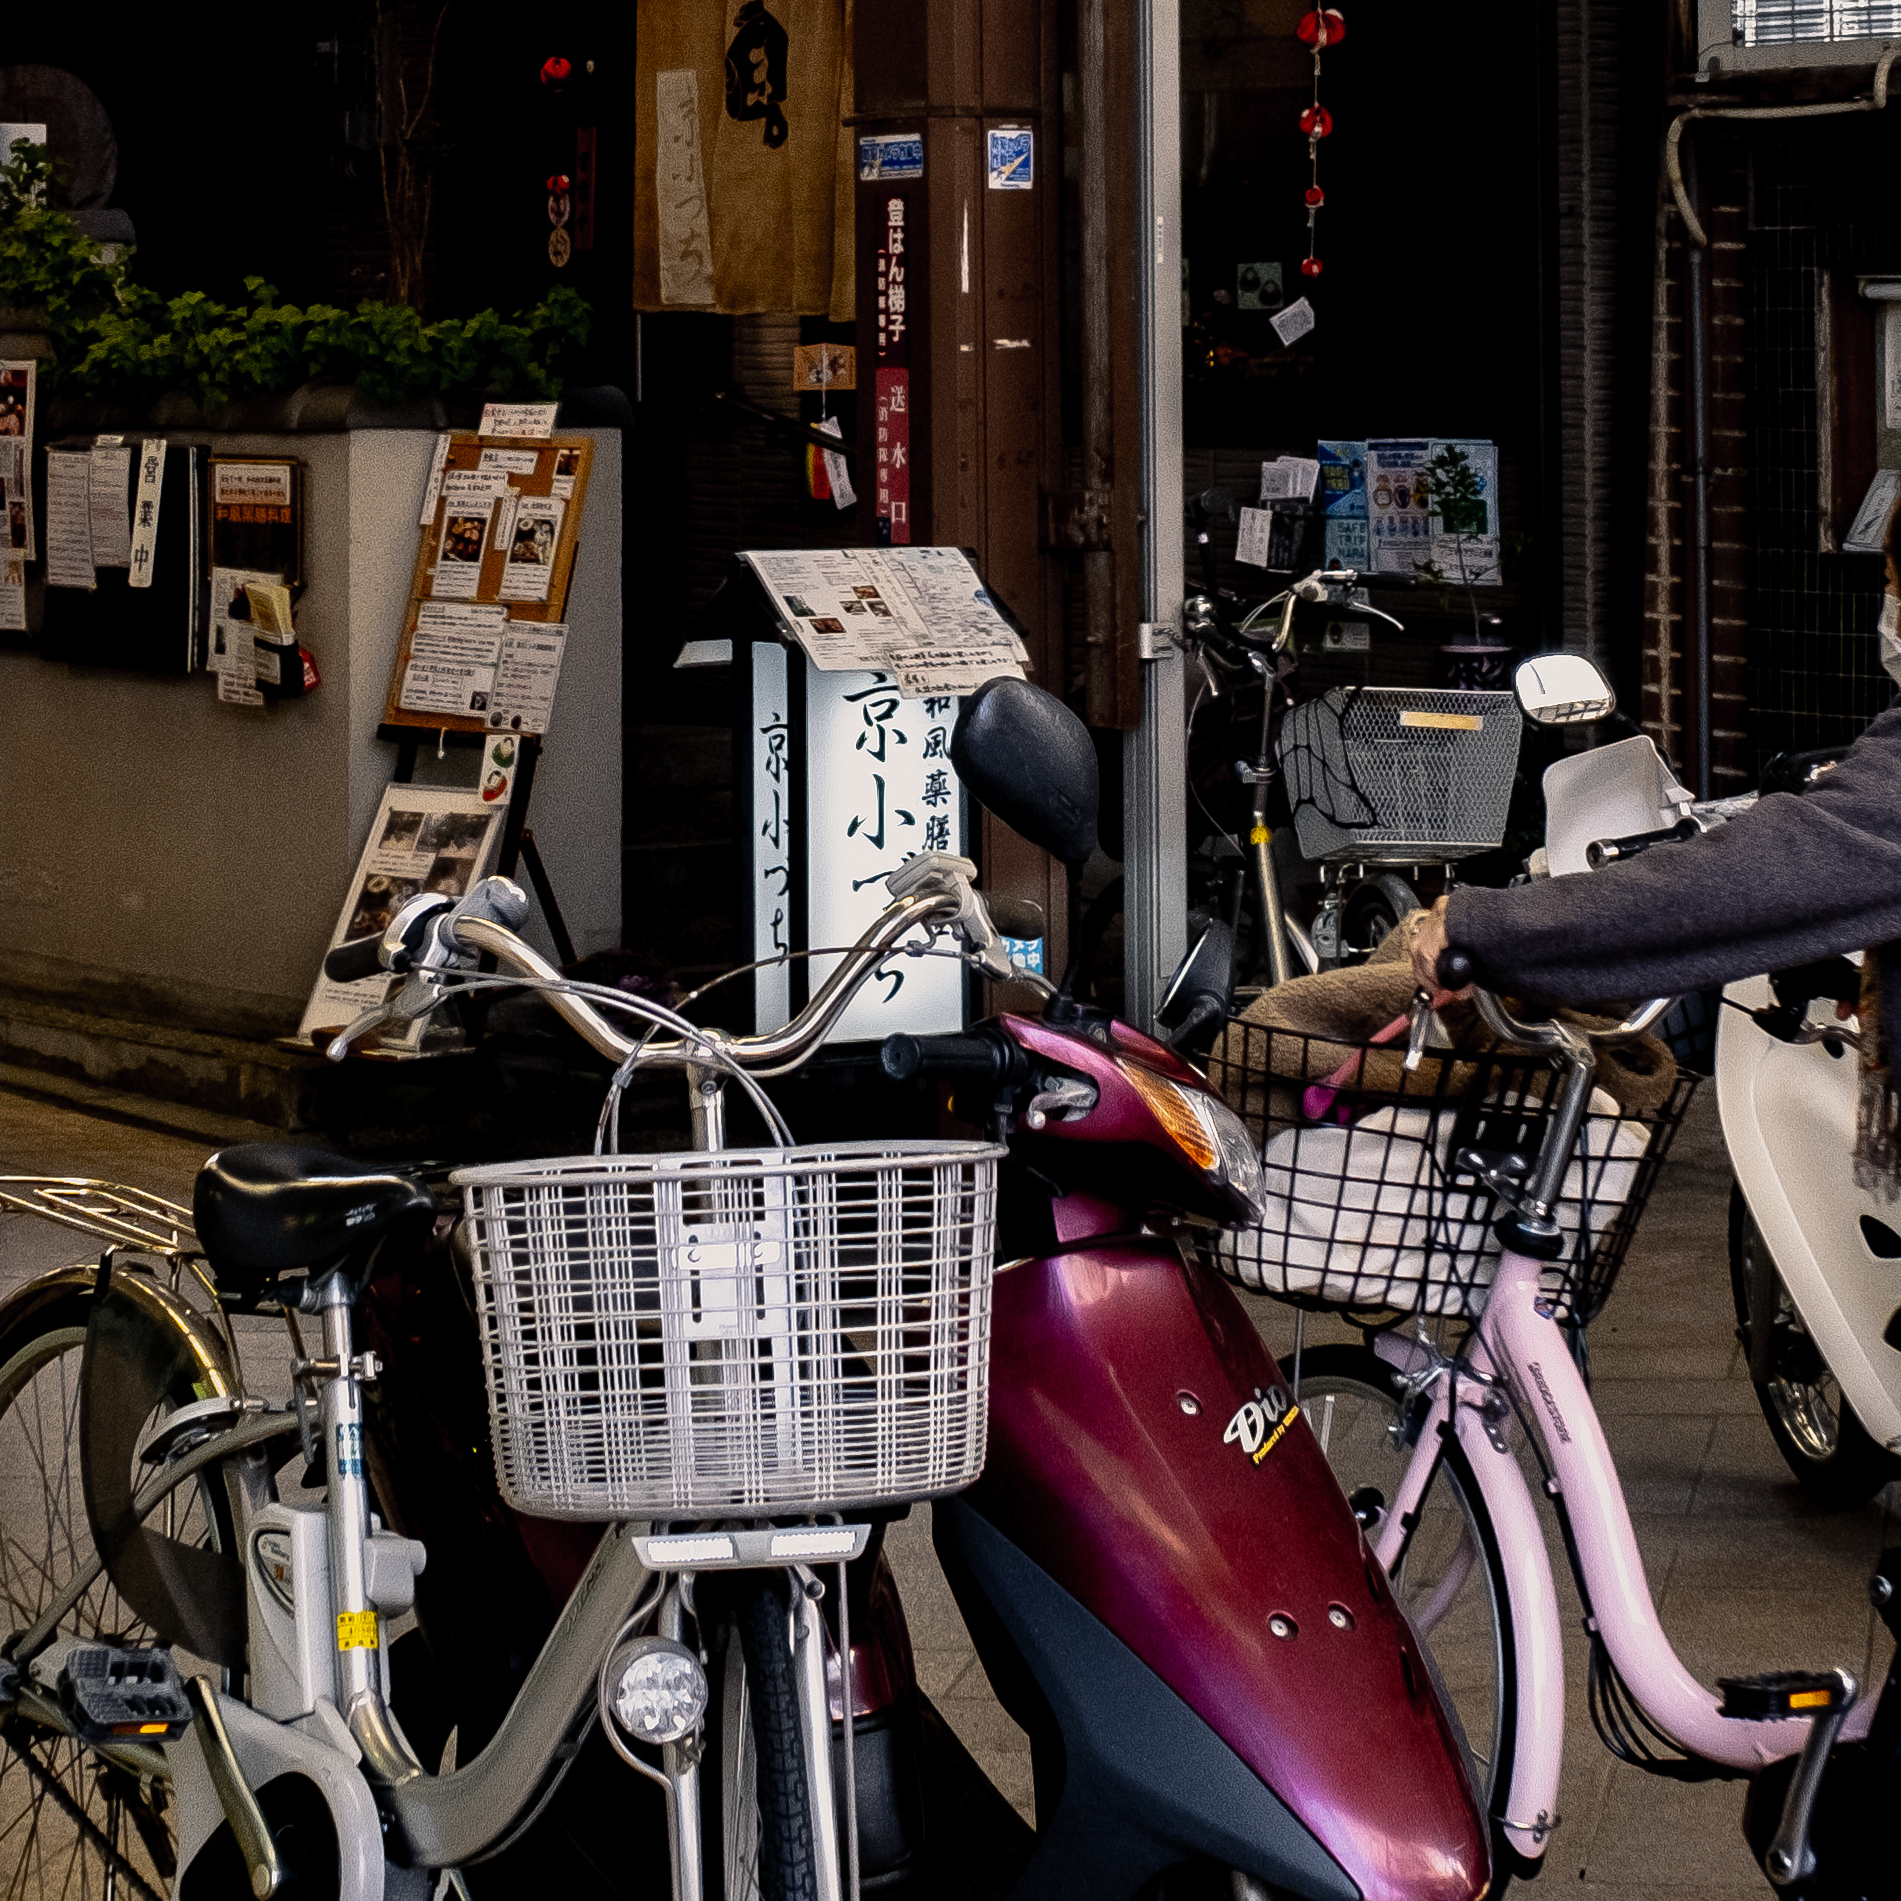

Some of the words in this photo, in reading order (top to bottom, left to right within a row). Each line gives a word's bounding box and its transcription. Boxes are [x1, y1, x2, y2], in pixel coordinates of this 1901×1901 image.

[887, 198, 906, 343] 登はん梯子
[134, 455, 159, 573] 営業中
[889, 384, 906, 525] 送水口
[1224, 1386, 1286, 1452] Dio
